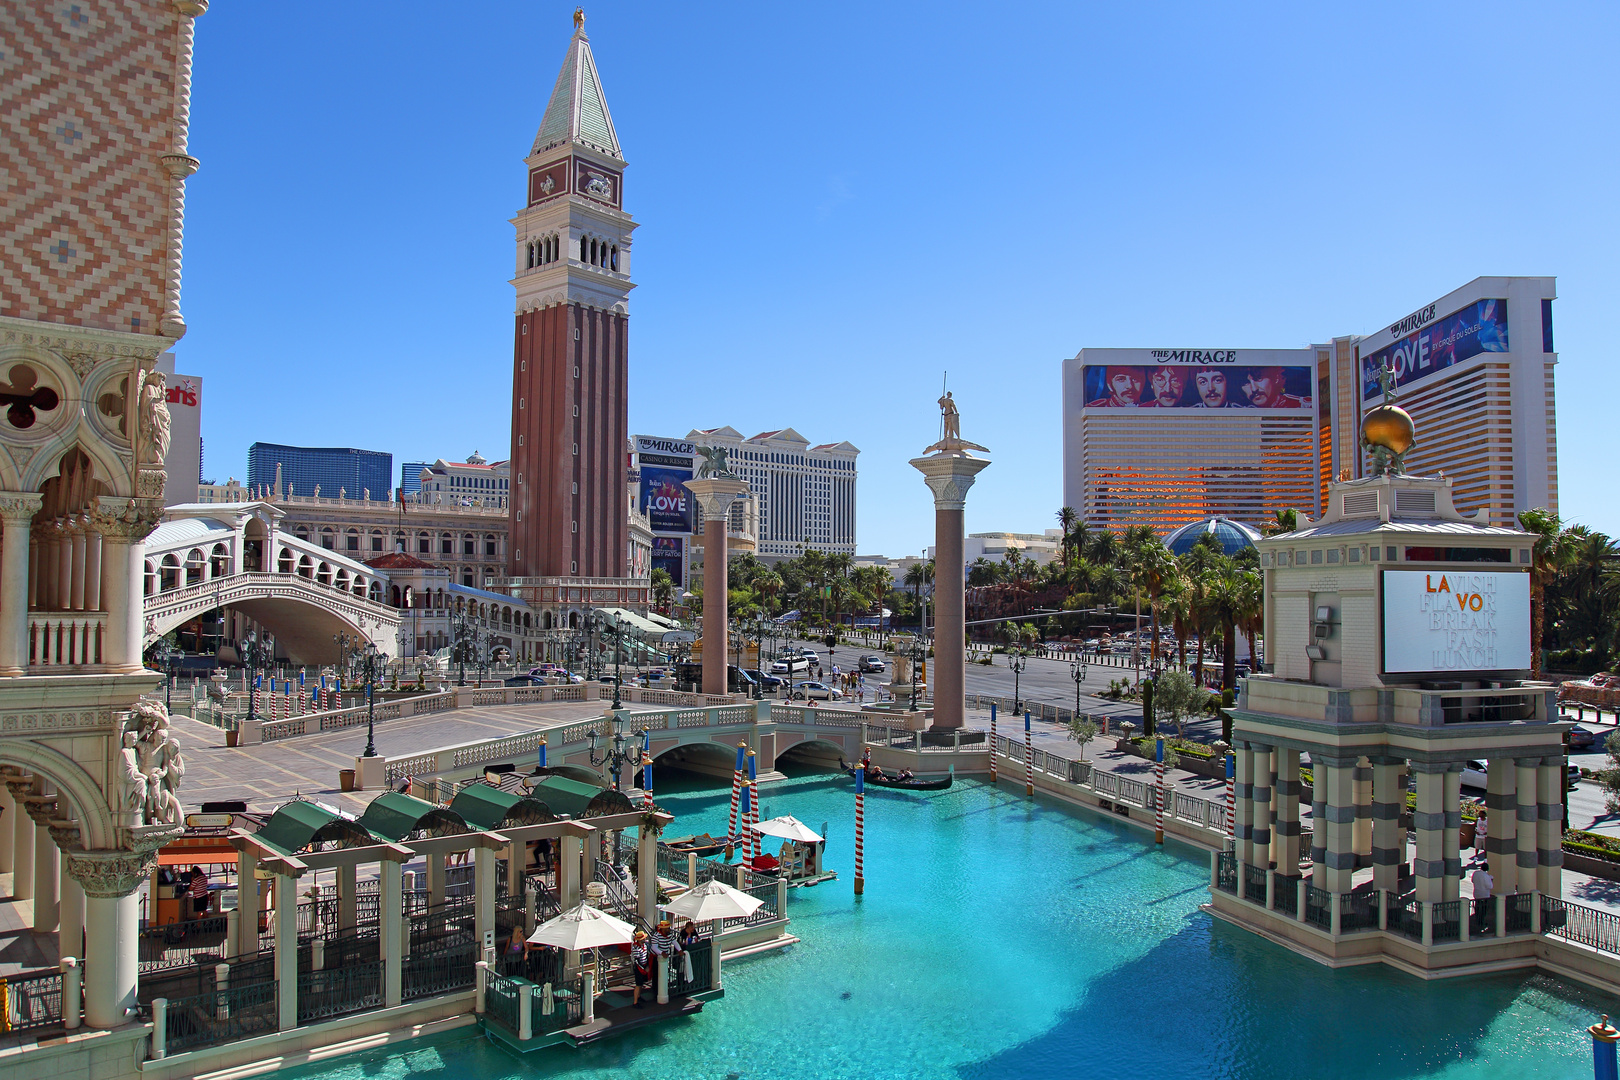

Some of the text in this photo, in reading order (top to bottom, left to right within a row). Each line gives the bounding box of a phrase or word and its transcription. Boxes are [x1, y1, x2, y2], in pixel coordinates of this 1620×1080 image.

[1393, 304, 1436, 338] MIRAGE
[1151, 350, 1236, 364] THE MIRAGE
[1383, 335, 1431, 381] LOVE
[1432, 343, 1438, 351] BY
[1438, 334, 1456, 348] CIRQUE
[1456, 331, 1464, 340] DU
[1464, 323, 1483, 336] SOLEIL
[642, 440, 694, 453] MIRAGE
[648, 495, 687, 511] LOVE
[1429, 612, 1497, 631] BREAK
[1446, 631, 1497, 649] FAST
[1432, 649, 1498, 669] LUNCH
